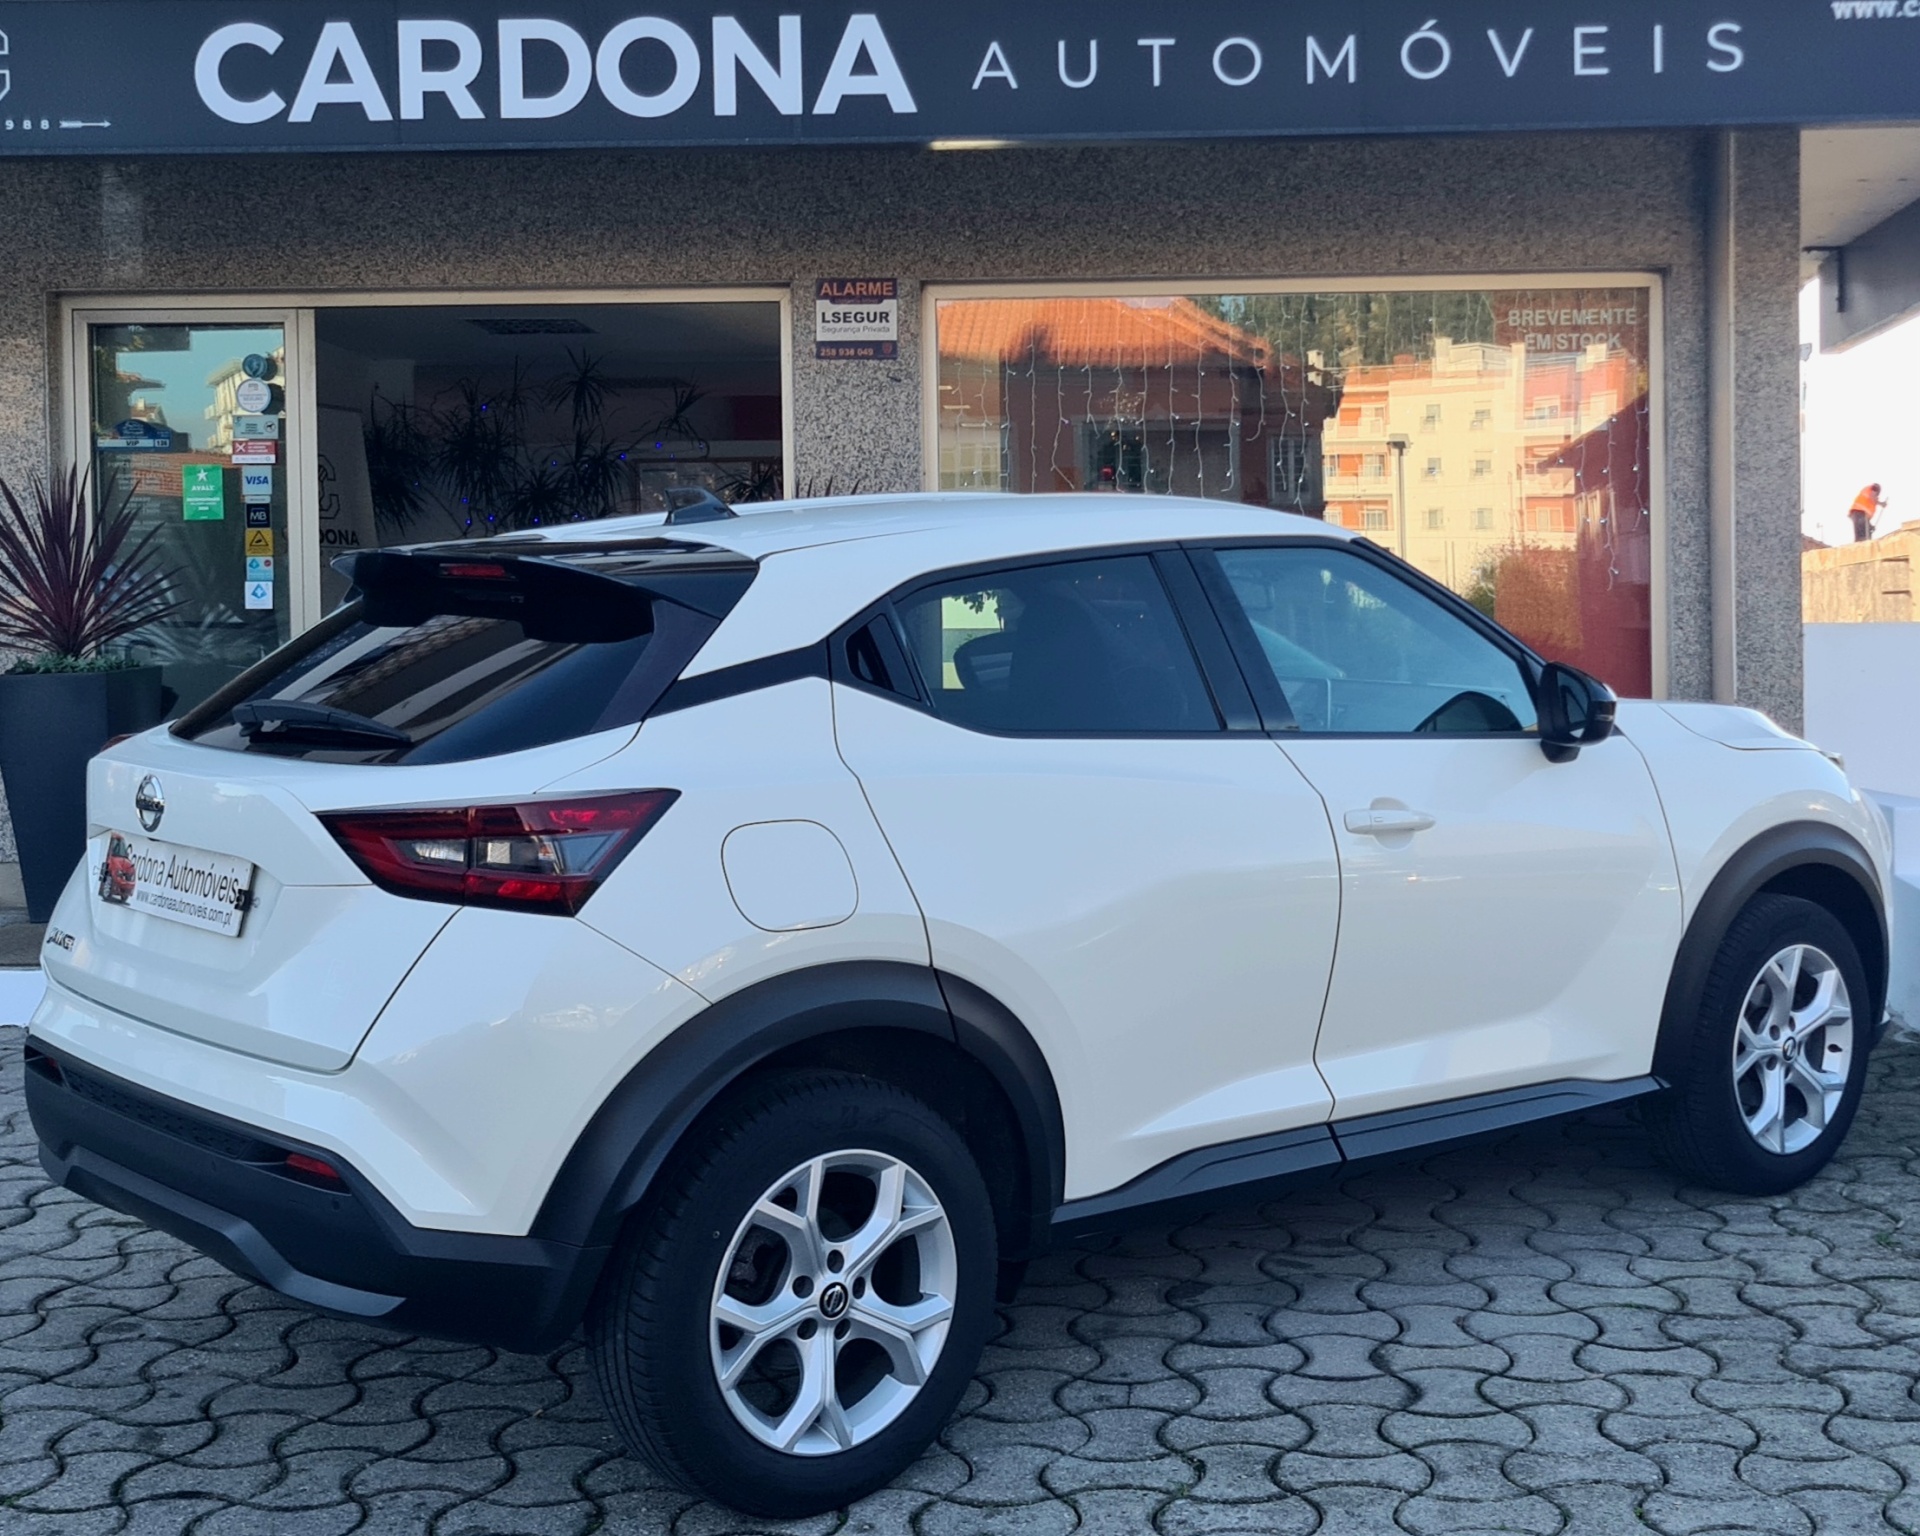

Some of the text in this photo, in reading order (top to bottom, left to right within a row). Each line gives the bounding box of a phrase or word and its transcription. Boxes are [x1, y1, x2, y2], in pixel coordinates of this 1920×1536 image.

[1830, 0, 1920, 20] www.c
[194, 13, 1746, 124] CARDONA AUTOMÓVEIS
[820, 281, 894, 296] ALARME
[821, 311, 890, 324] LSEGUR
[1508, 308, 1637, 326] BREVEMENTE
[821, 325, 890, 335] Segurança Privada
[1525, 332, 1621, 350] EM STOCK
[245, 475, 269, 485] VISA
[249, 511, 267, 521] MB
[165, 854, 240, 904] Automóveis
